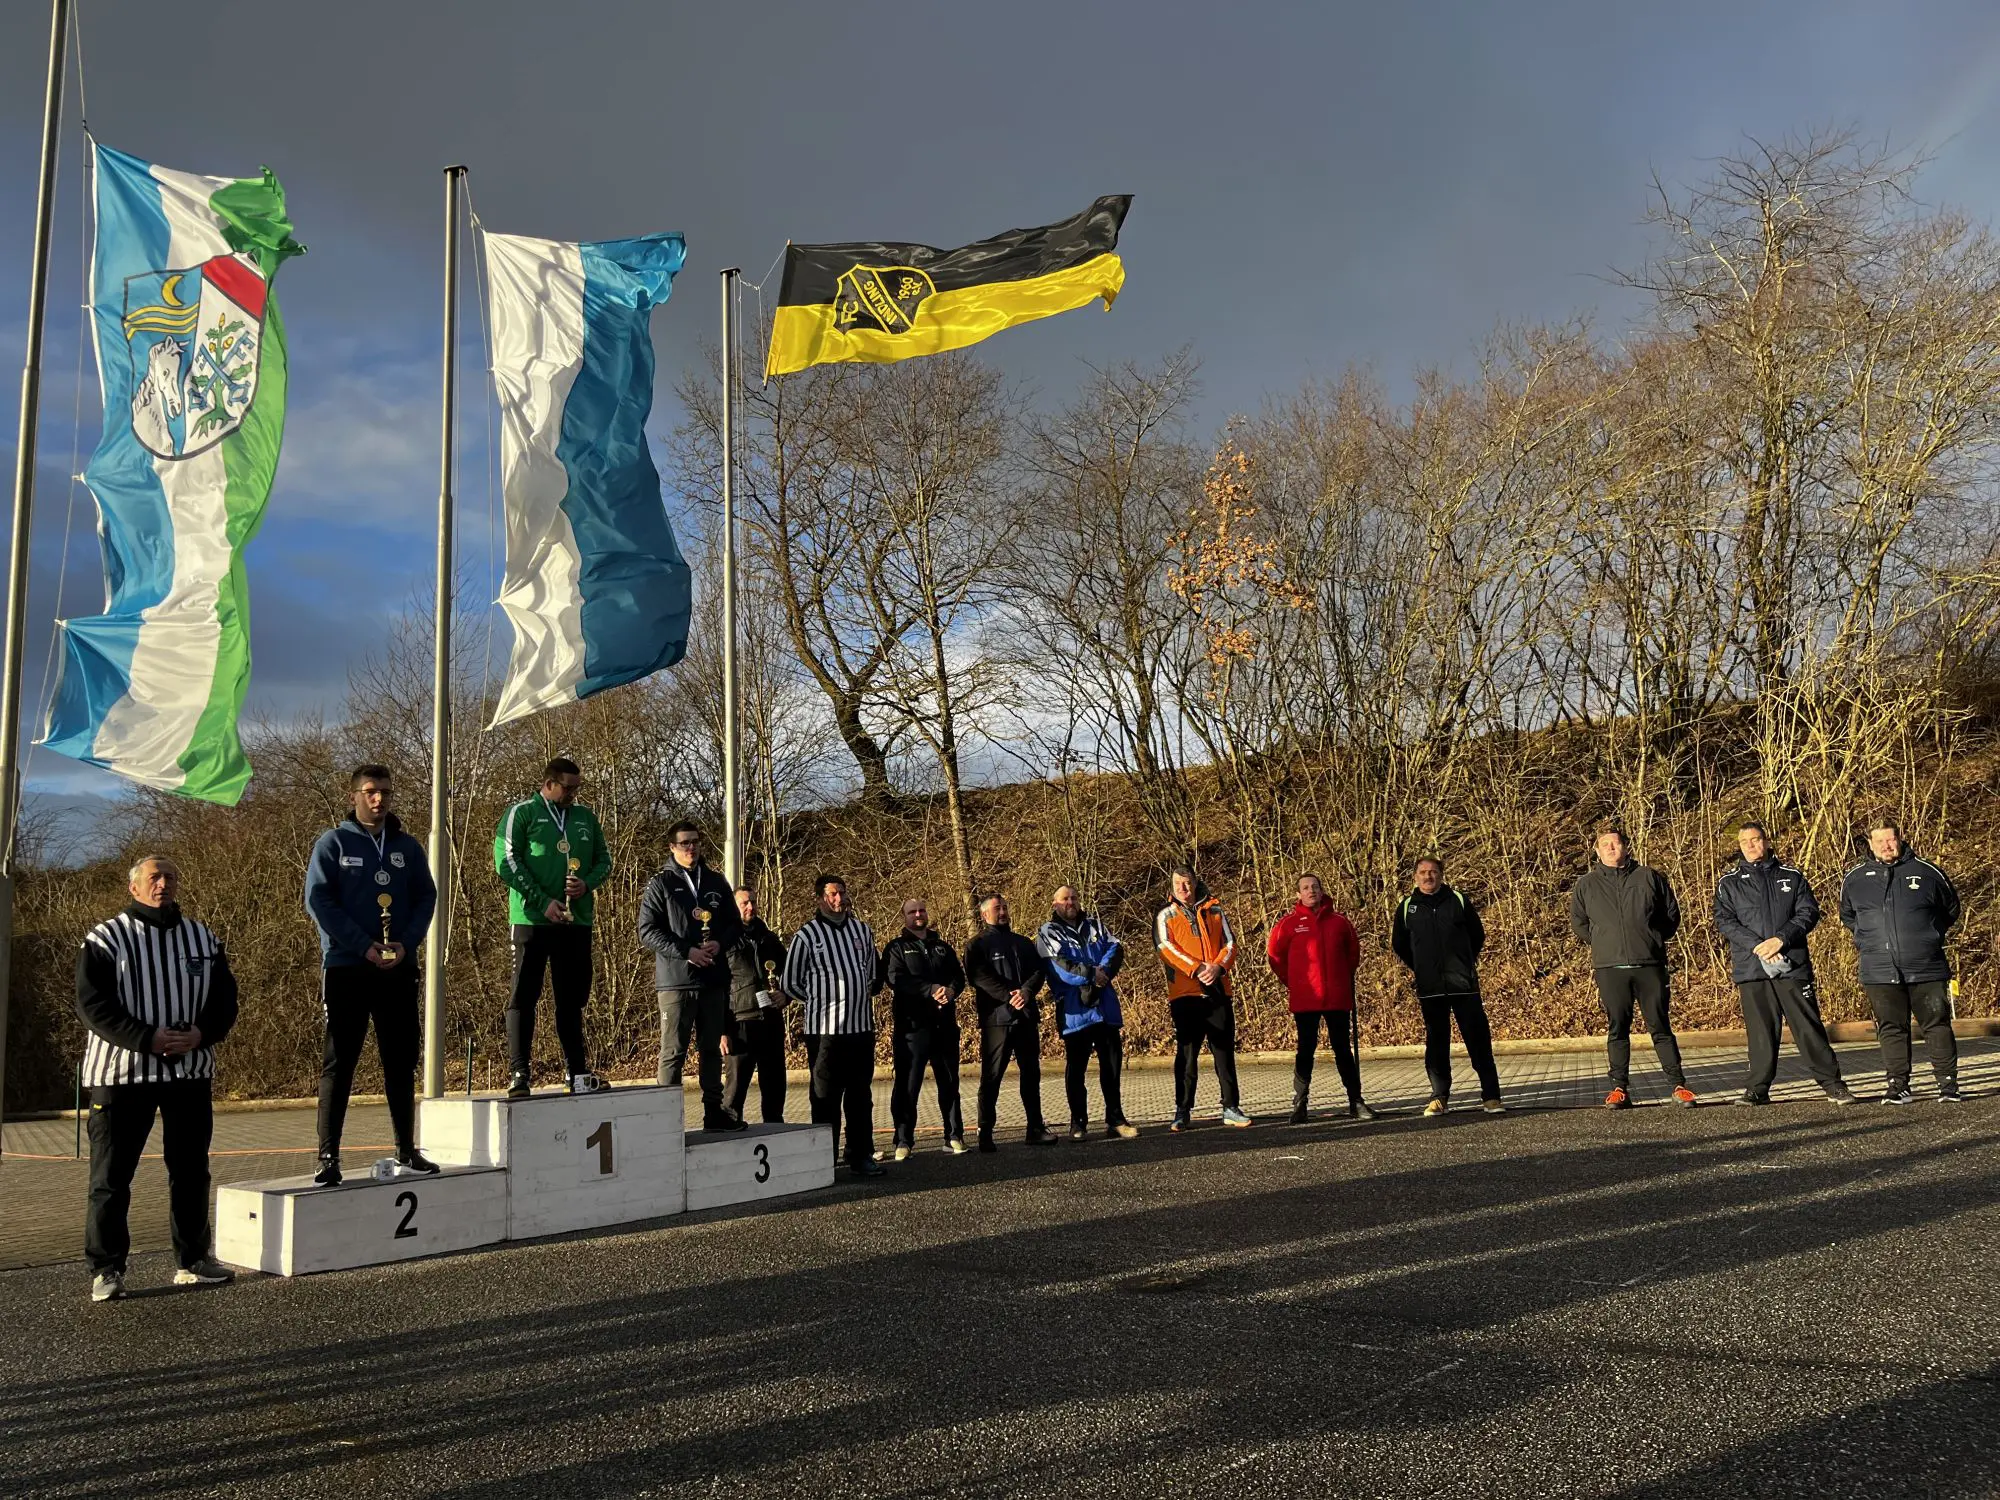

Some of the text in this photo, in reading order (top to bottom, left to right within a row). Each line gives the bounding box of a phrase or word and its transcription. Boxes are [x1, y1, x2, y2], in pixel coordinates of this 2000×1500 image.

[863, 280, 898, 326] INDLING
[897, 277, 914, 301] 1960
[840, 300, 859, 325] FC
[586, 1121, 613, 1175] 1
[753, 1143, 771, 1184] 3
[393, 1190, 418, 1240] 2
